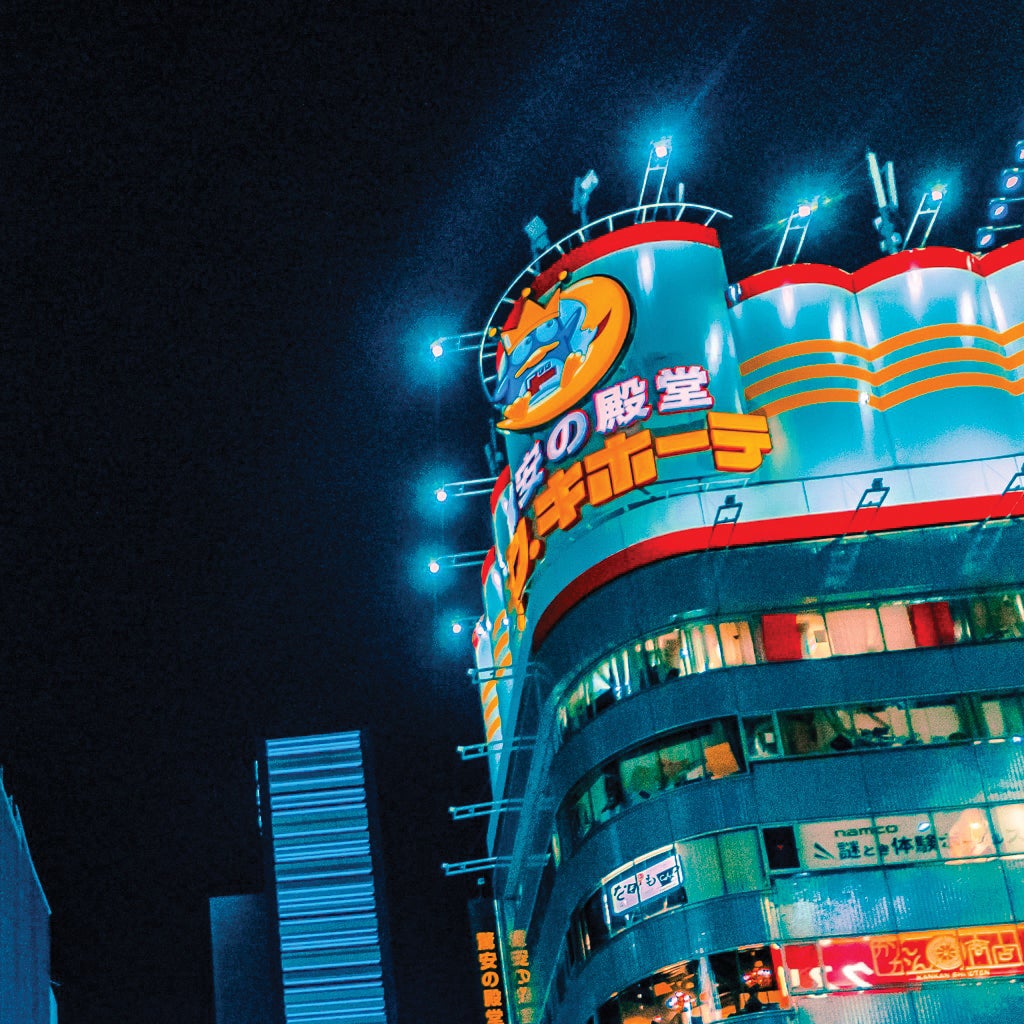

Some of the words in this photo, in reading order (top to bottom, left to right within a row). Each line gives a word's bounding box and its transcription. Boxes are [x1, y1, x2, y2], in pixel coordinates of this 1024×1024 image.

[508, 364, 715, 535] 安の殿堂
[834, 824, 899, 838] namco
